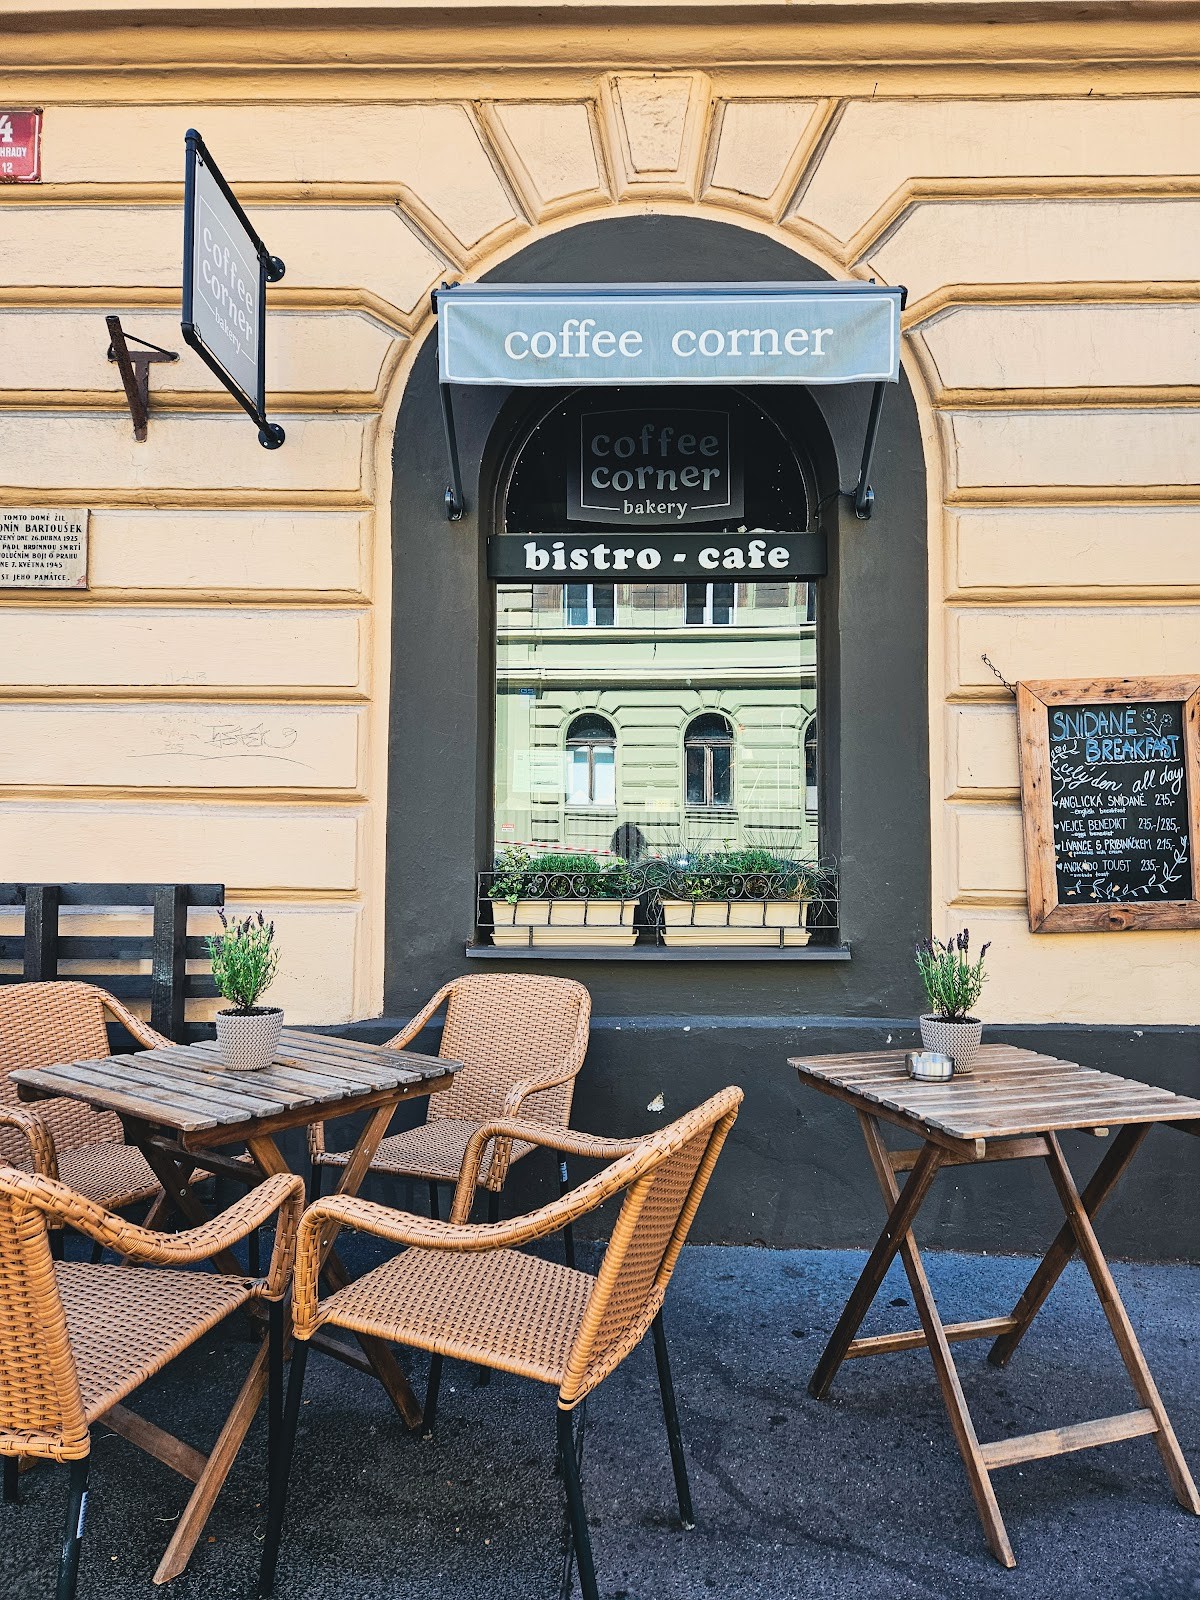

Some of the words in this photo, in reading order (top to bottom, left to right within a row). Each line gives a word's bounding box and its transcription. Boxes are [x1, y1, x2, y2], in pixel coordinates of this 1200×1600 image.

[0, 147, 27, 157] HRADY
[2, 162, 13, 173] 12
[203, 228, 253, 314] coffee
[202, 259, 253, 341] corner
[215, 306, 241, 354] bakery
[504, 319, 643, 360] coffee
[671, 327, 833, 357] corner
[591, 424, 720, 458] coffee
[591, 465, 721, 491] corner
[623, 499, 688, 520] bakery
[25, 522, 82, 533] BARTOUŠEK
[523, 541, 661, 571] bistro
[698, 539, 790, 569] cafe
[13, 573, 31, 581] JEHO
[1052, 705, 1137, 741] SNÍDANĚ
[1085, 735, 1180, 762] BREAKFAST
[1091, 771, 1122, 791] den
[1132, 769, 1156, 793] all
[1160, 765, 1183, 795] day
[1059, 793, 1103, 808] ANGLICKÁ
[1060, 819, 1085, 832] VEJCE
[1088, 818, 1127, 831] BENEDIKT
[1102, 859, 1131, 872] TOUST
